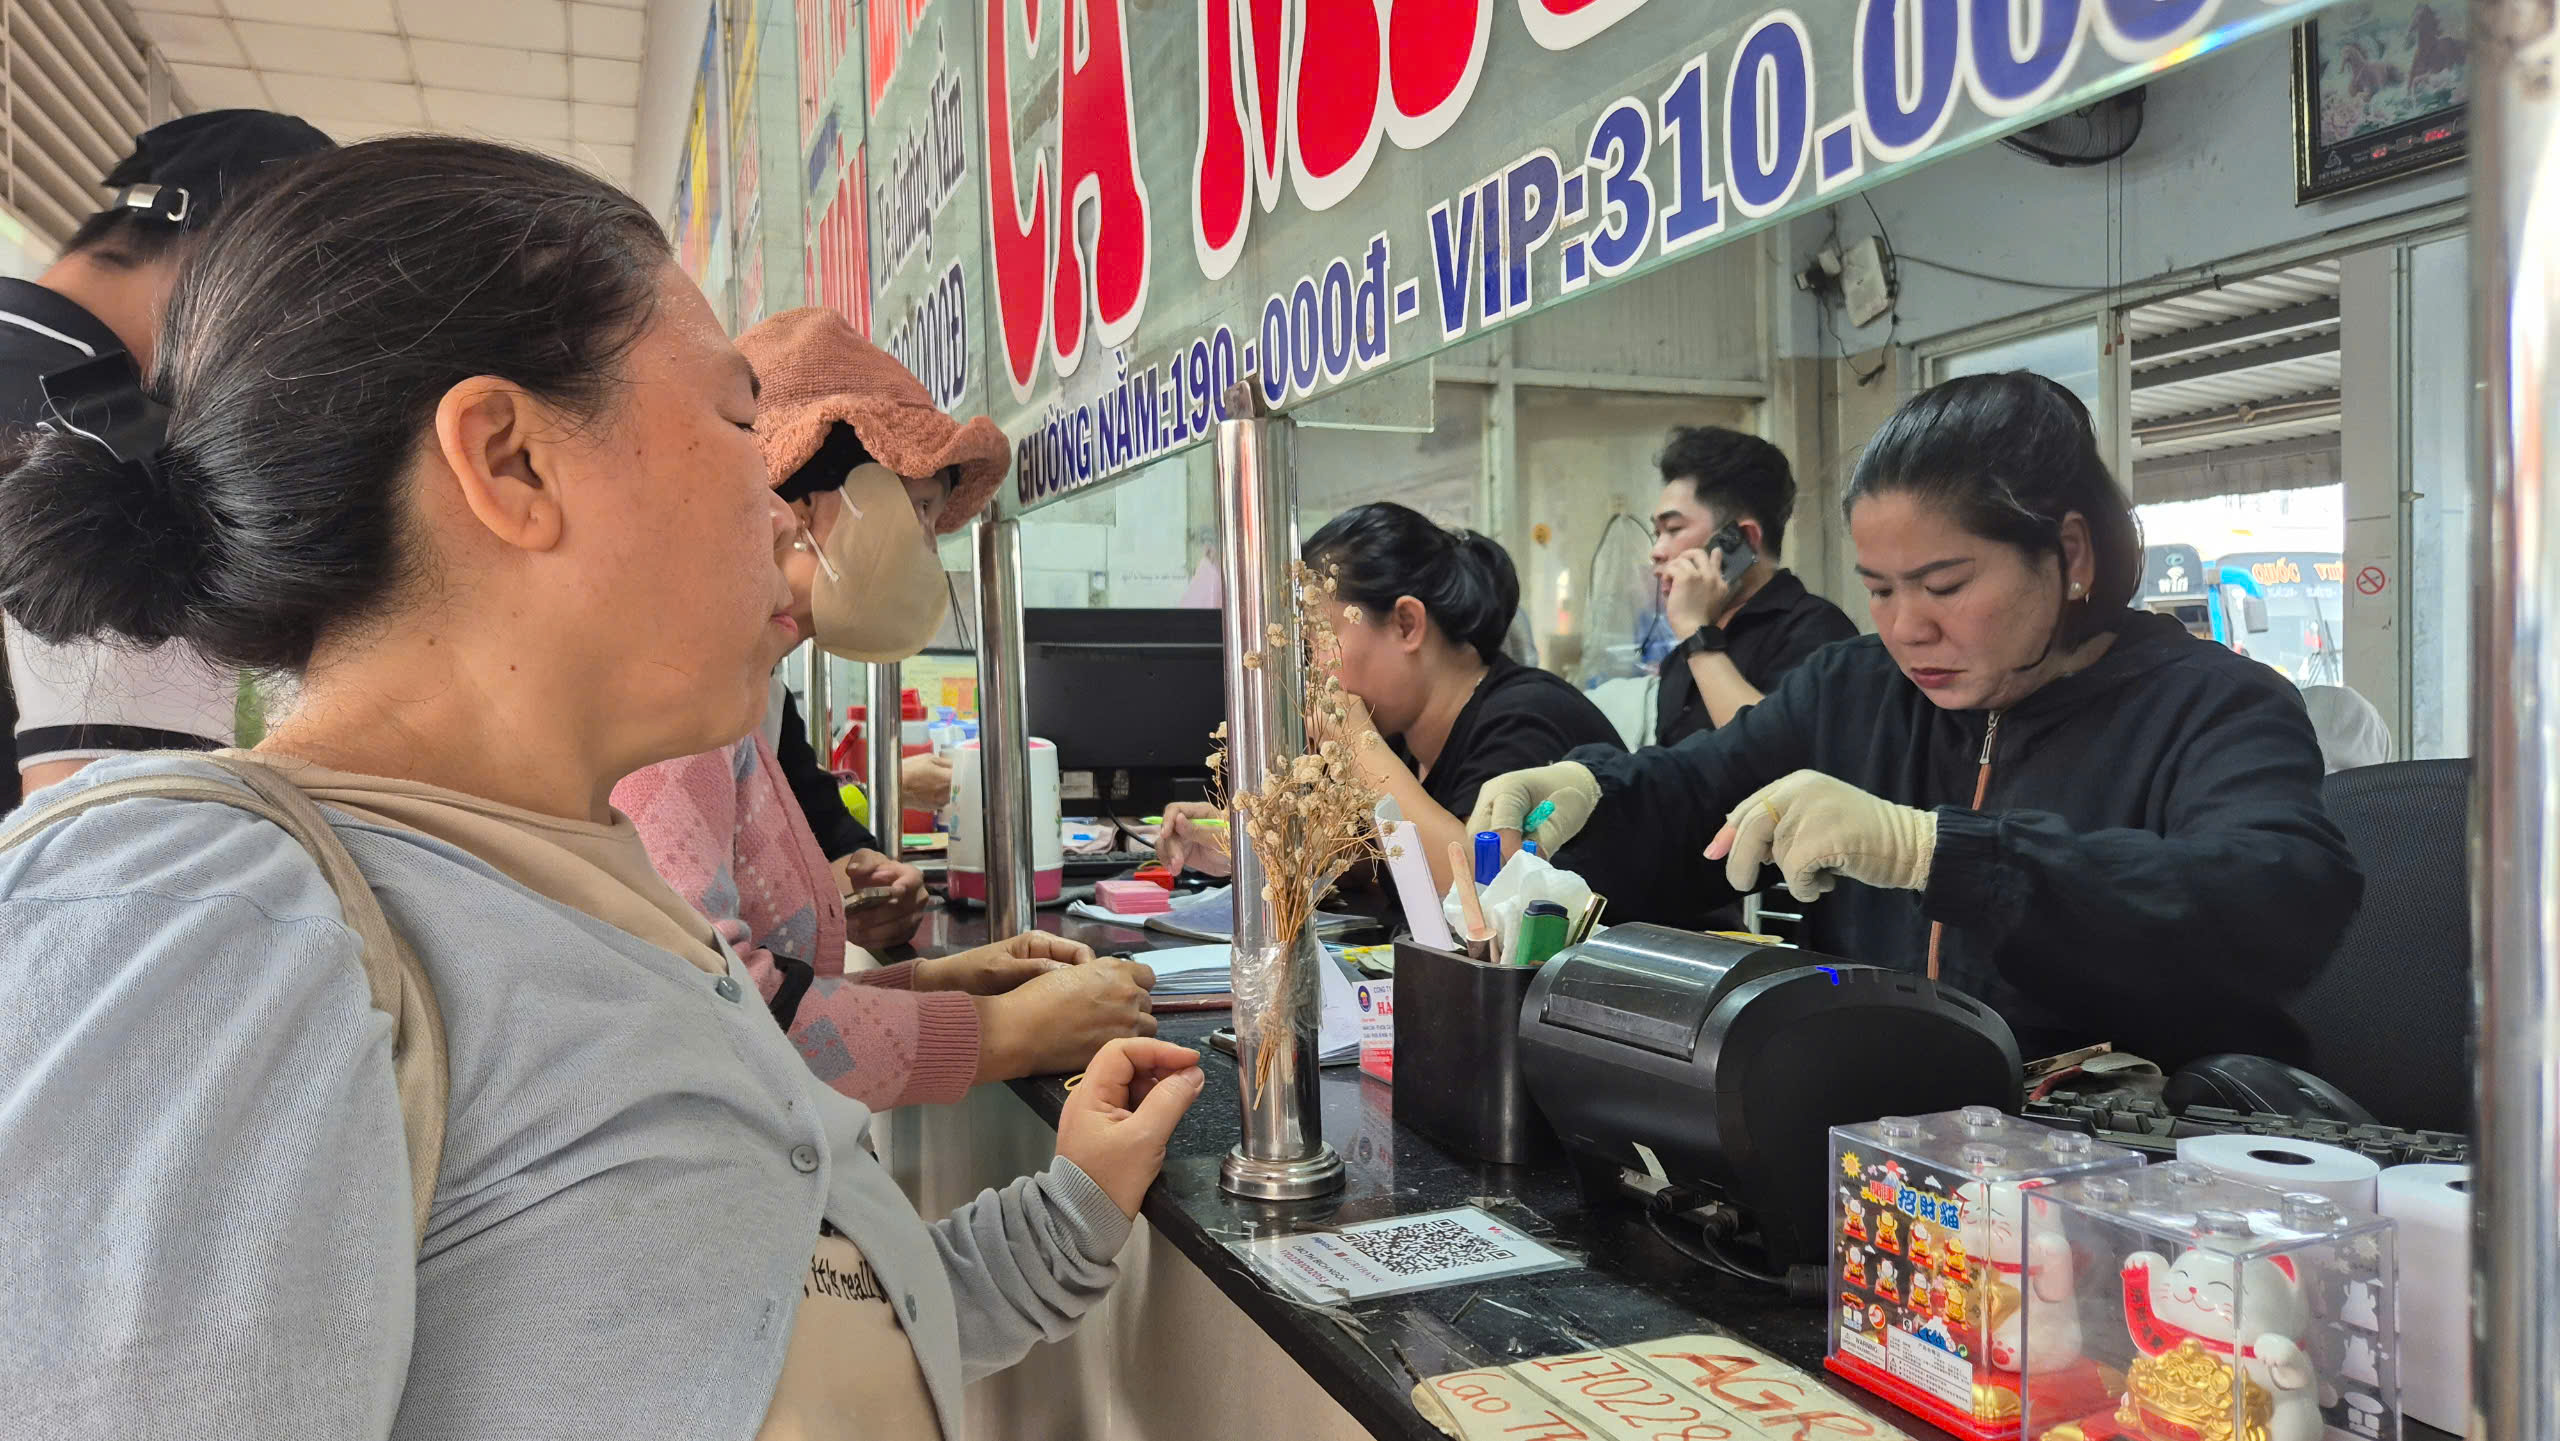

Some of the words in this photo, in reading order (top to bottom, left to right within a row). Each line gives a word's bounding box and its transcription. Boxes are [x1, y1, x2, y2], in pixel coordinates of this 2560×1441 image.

[1018, 402, 1093, 506] GIƯỜNG
[1344, 1256, 1385, 1283] AGRIBANK
[1436, 1371, 1512, 1414] Cao
